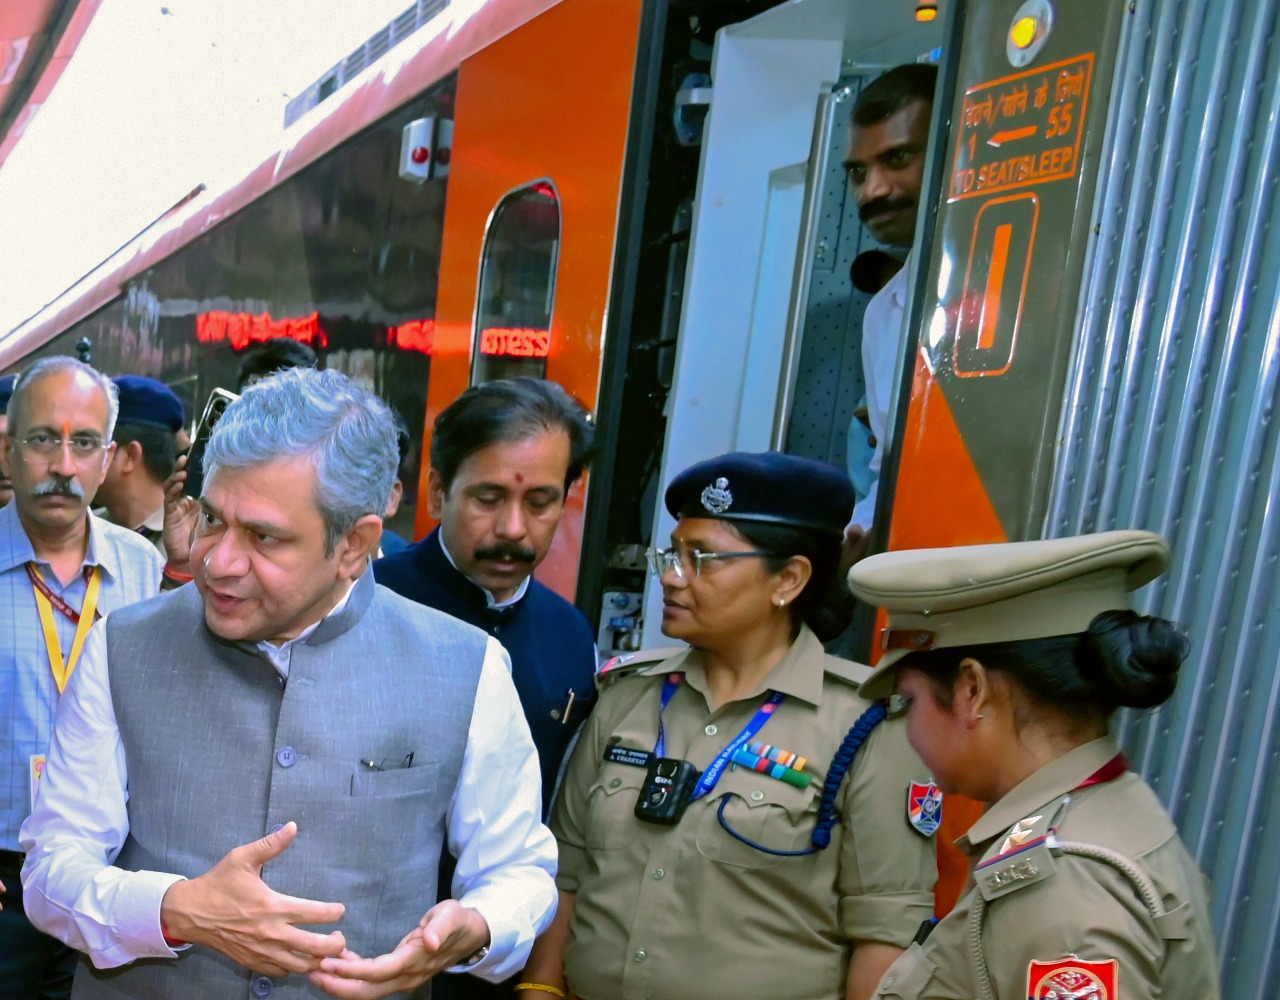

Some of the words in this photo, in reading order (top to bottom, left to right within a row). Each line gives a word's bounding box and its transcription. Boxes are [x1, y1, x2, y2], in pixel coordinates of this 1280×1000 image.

[1044, 102, 1074, 139] 55
[952, 167, 976, 194] TO
[703, 758, 725, 786] INDIAN
